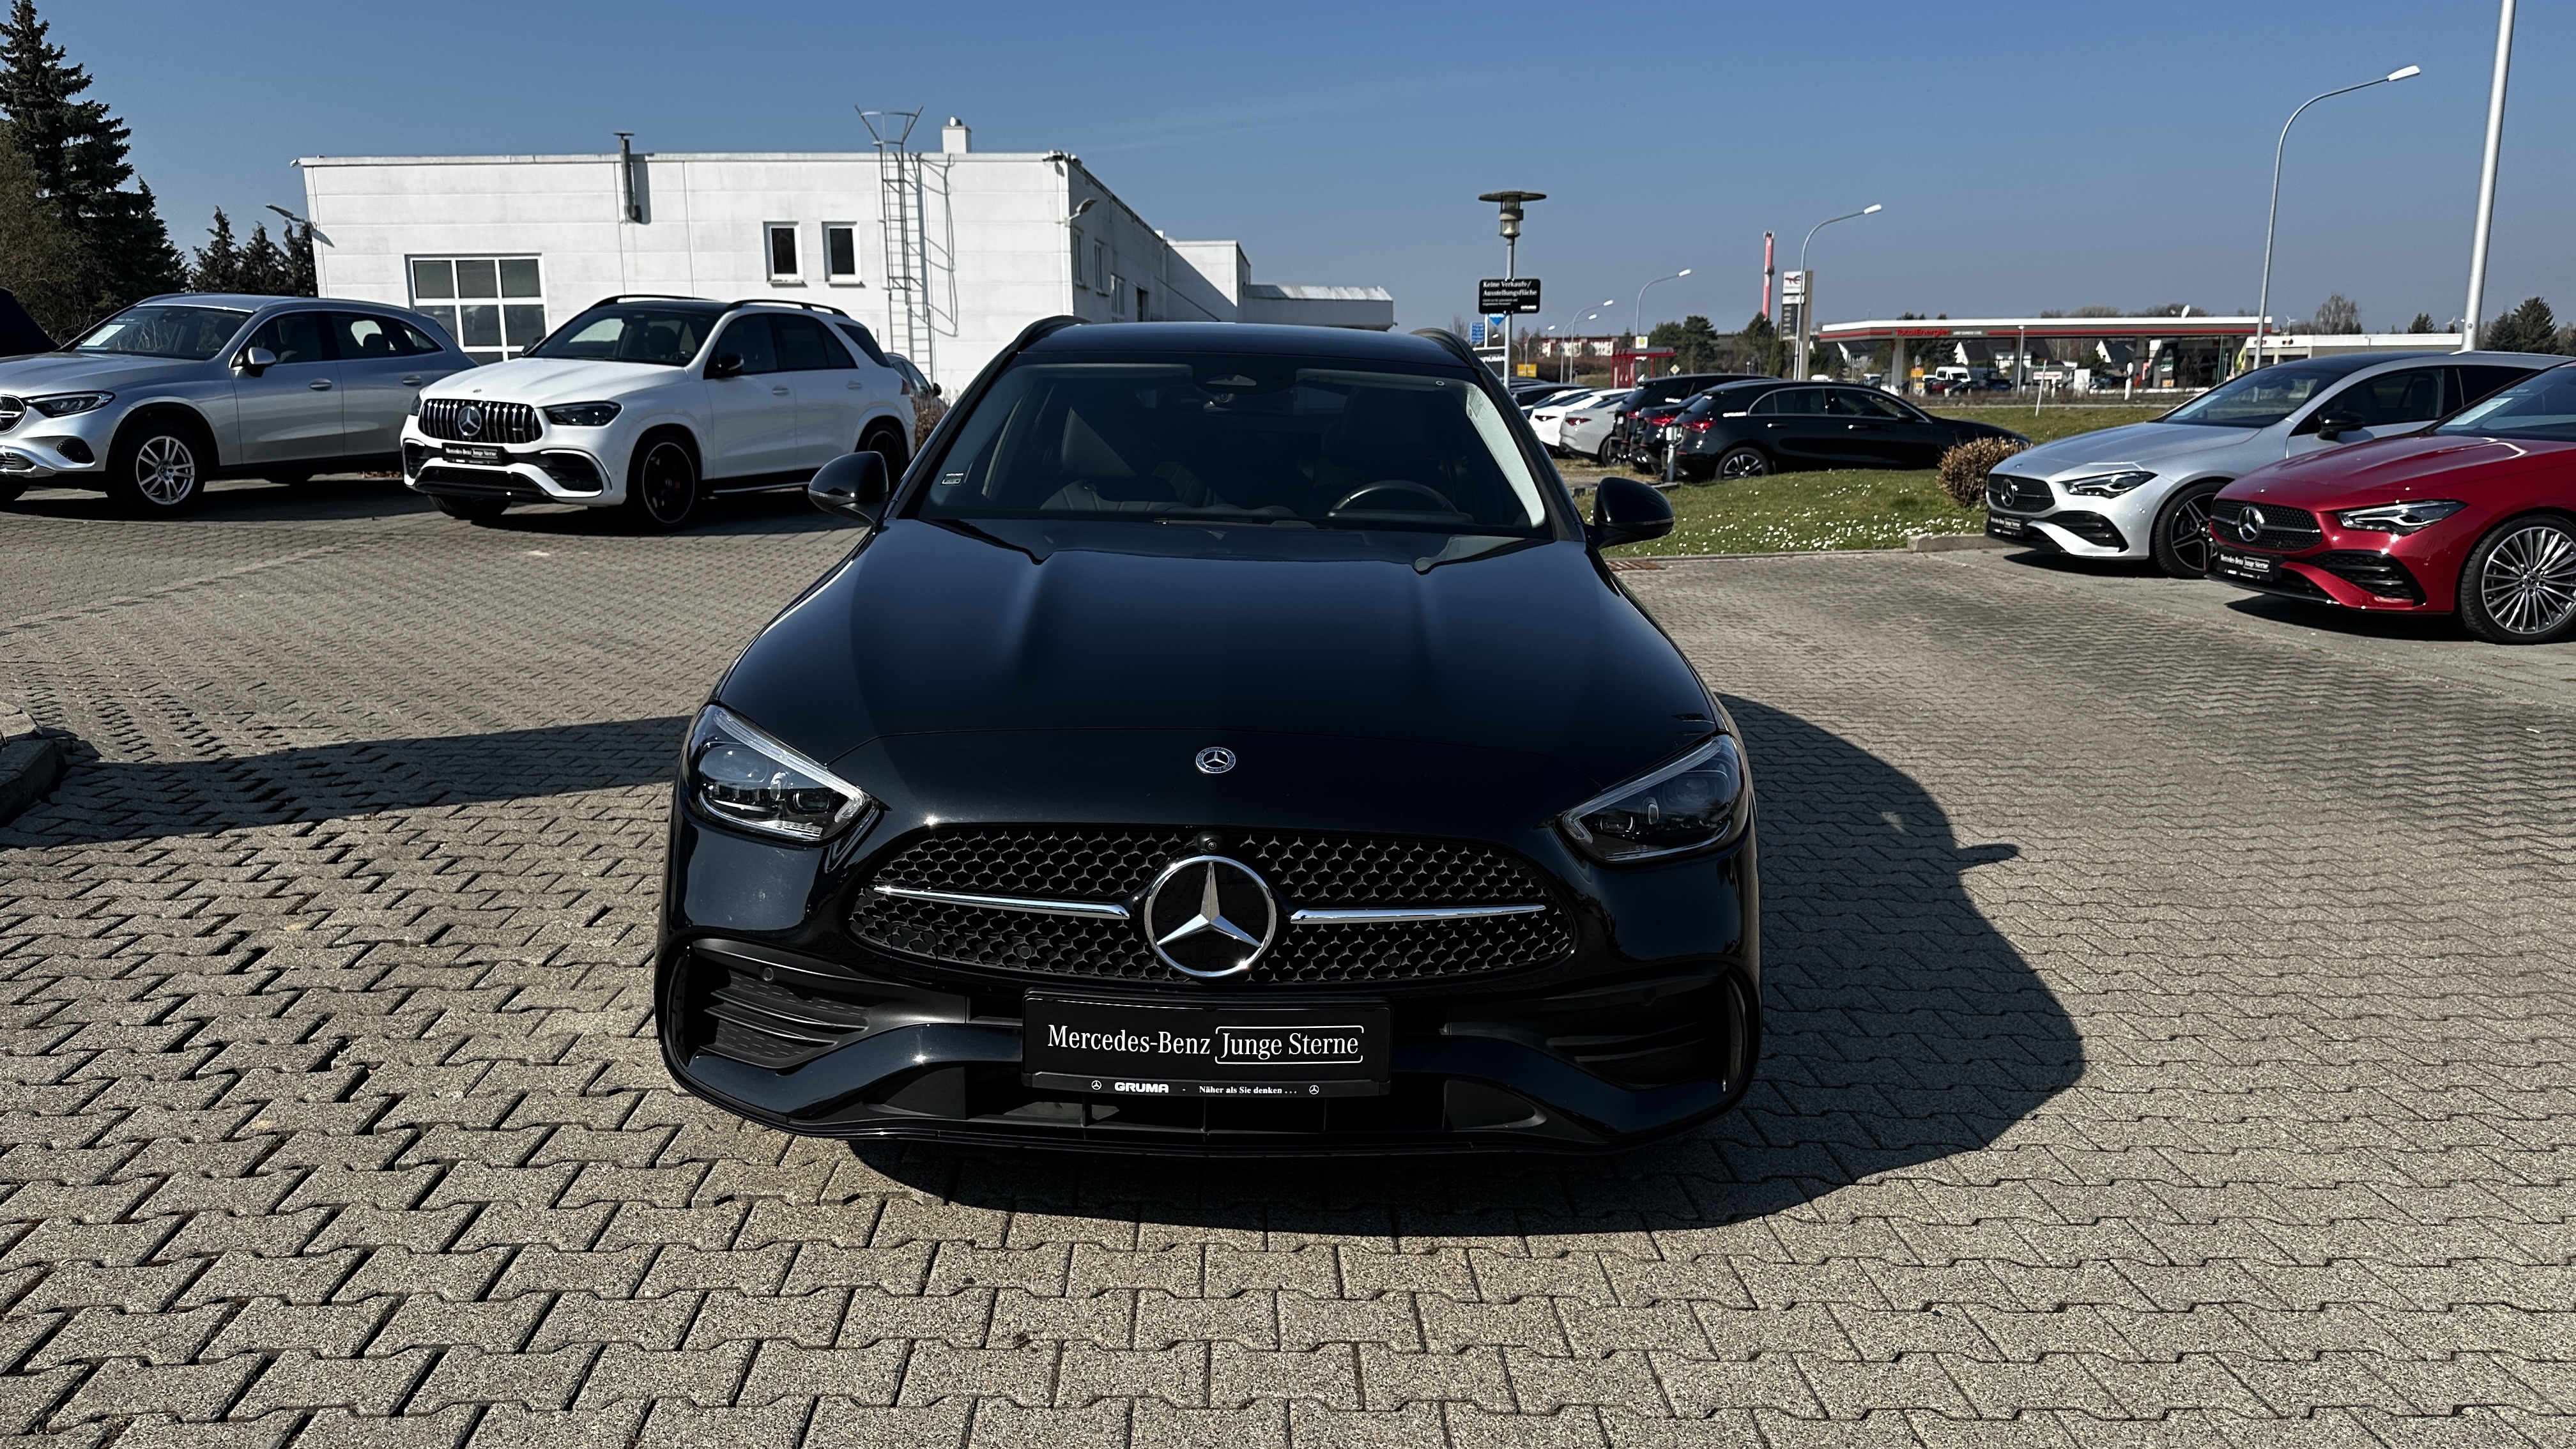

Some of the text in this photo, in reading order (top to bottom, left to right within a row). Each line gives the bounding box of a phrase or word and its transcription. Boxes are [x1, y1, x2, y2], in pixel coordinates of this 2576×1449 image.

[1047, 1024, 1359, 1060] Mercedes-Benz Junge Sterne
[1114, 1082, 1169, 1093] GRUMA
[1199, 1085, 1223, 1094] Näher
